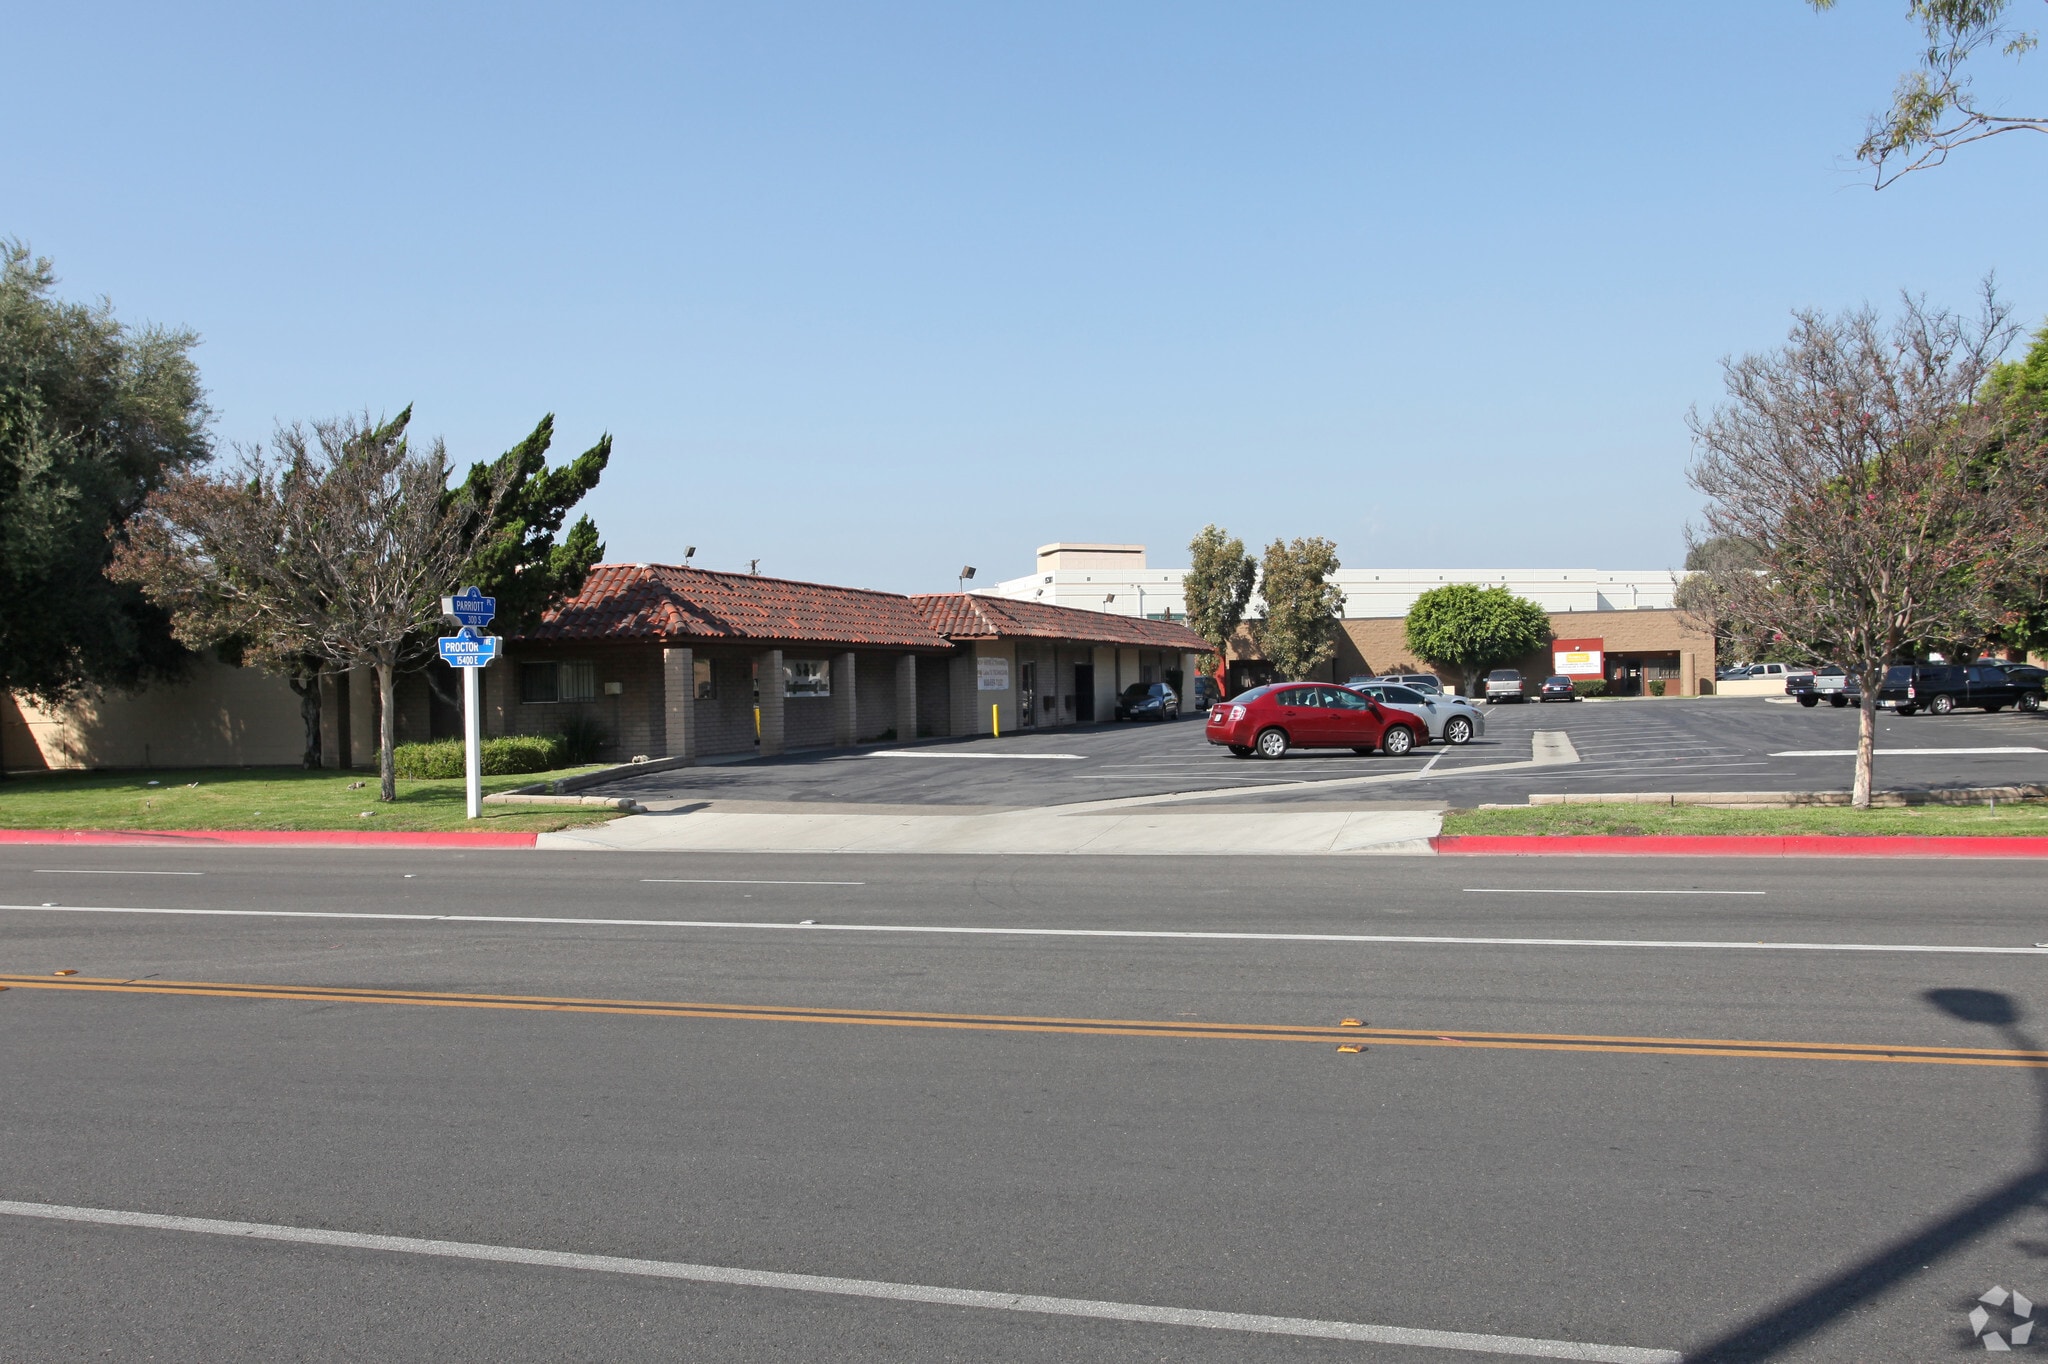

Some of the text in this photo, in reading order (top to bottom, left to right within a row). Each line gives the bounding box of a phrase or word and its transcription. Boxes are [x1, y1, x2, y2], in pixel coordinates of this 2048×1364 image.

[456, 601, 484, 612] PARRIOTT
[468, 615, 482, 624] 300 S
[445, 642, 479, 653] PROCTOR
[457, 656, 478, 665] 15400 E
